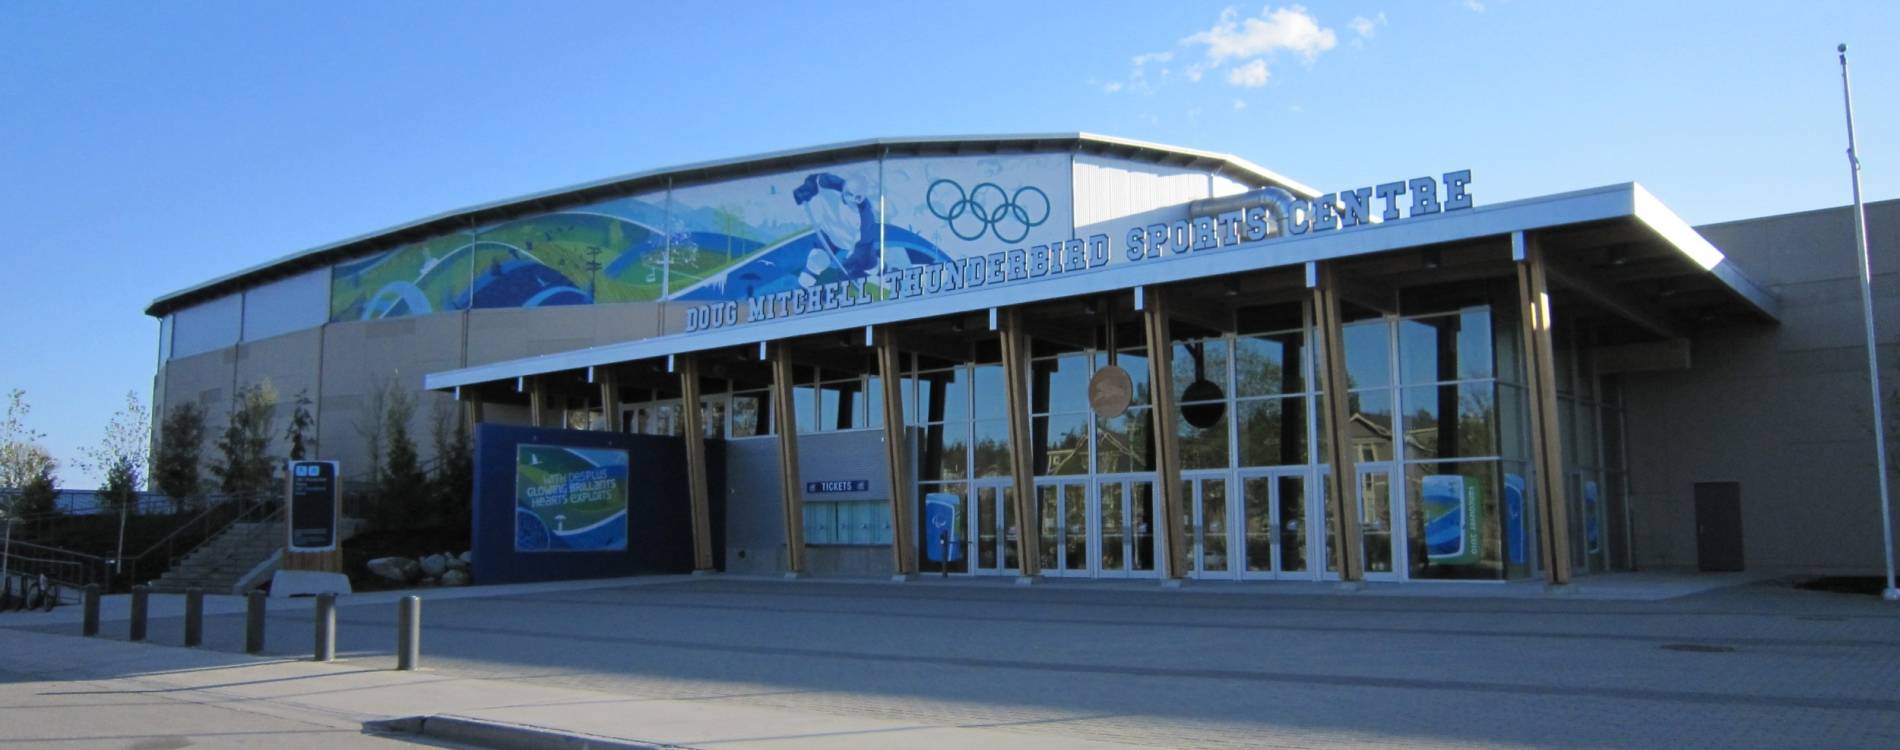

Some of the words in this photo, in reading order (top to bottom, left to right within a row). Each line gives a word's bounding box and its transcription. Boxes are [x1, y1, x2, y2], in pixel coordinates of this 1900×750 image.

[685, 302, 738, 333] DOUG
[747, 276, 873, 323] MITCHELL
[884, 232, 1111, 300] THUNDERBIRD
[1126, 206, 1270, 261] SPORTS
[1287, 169, 1474, 236] CENTRE
[822, 481, 852, 491] TICKETS
